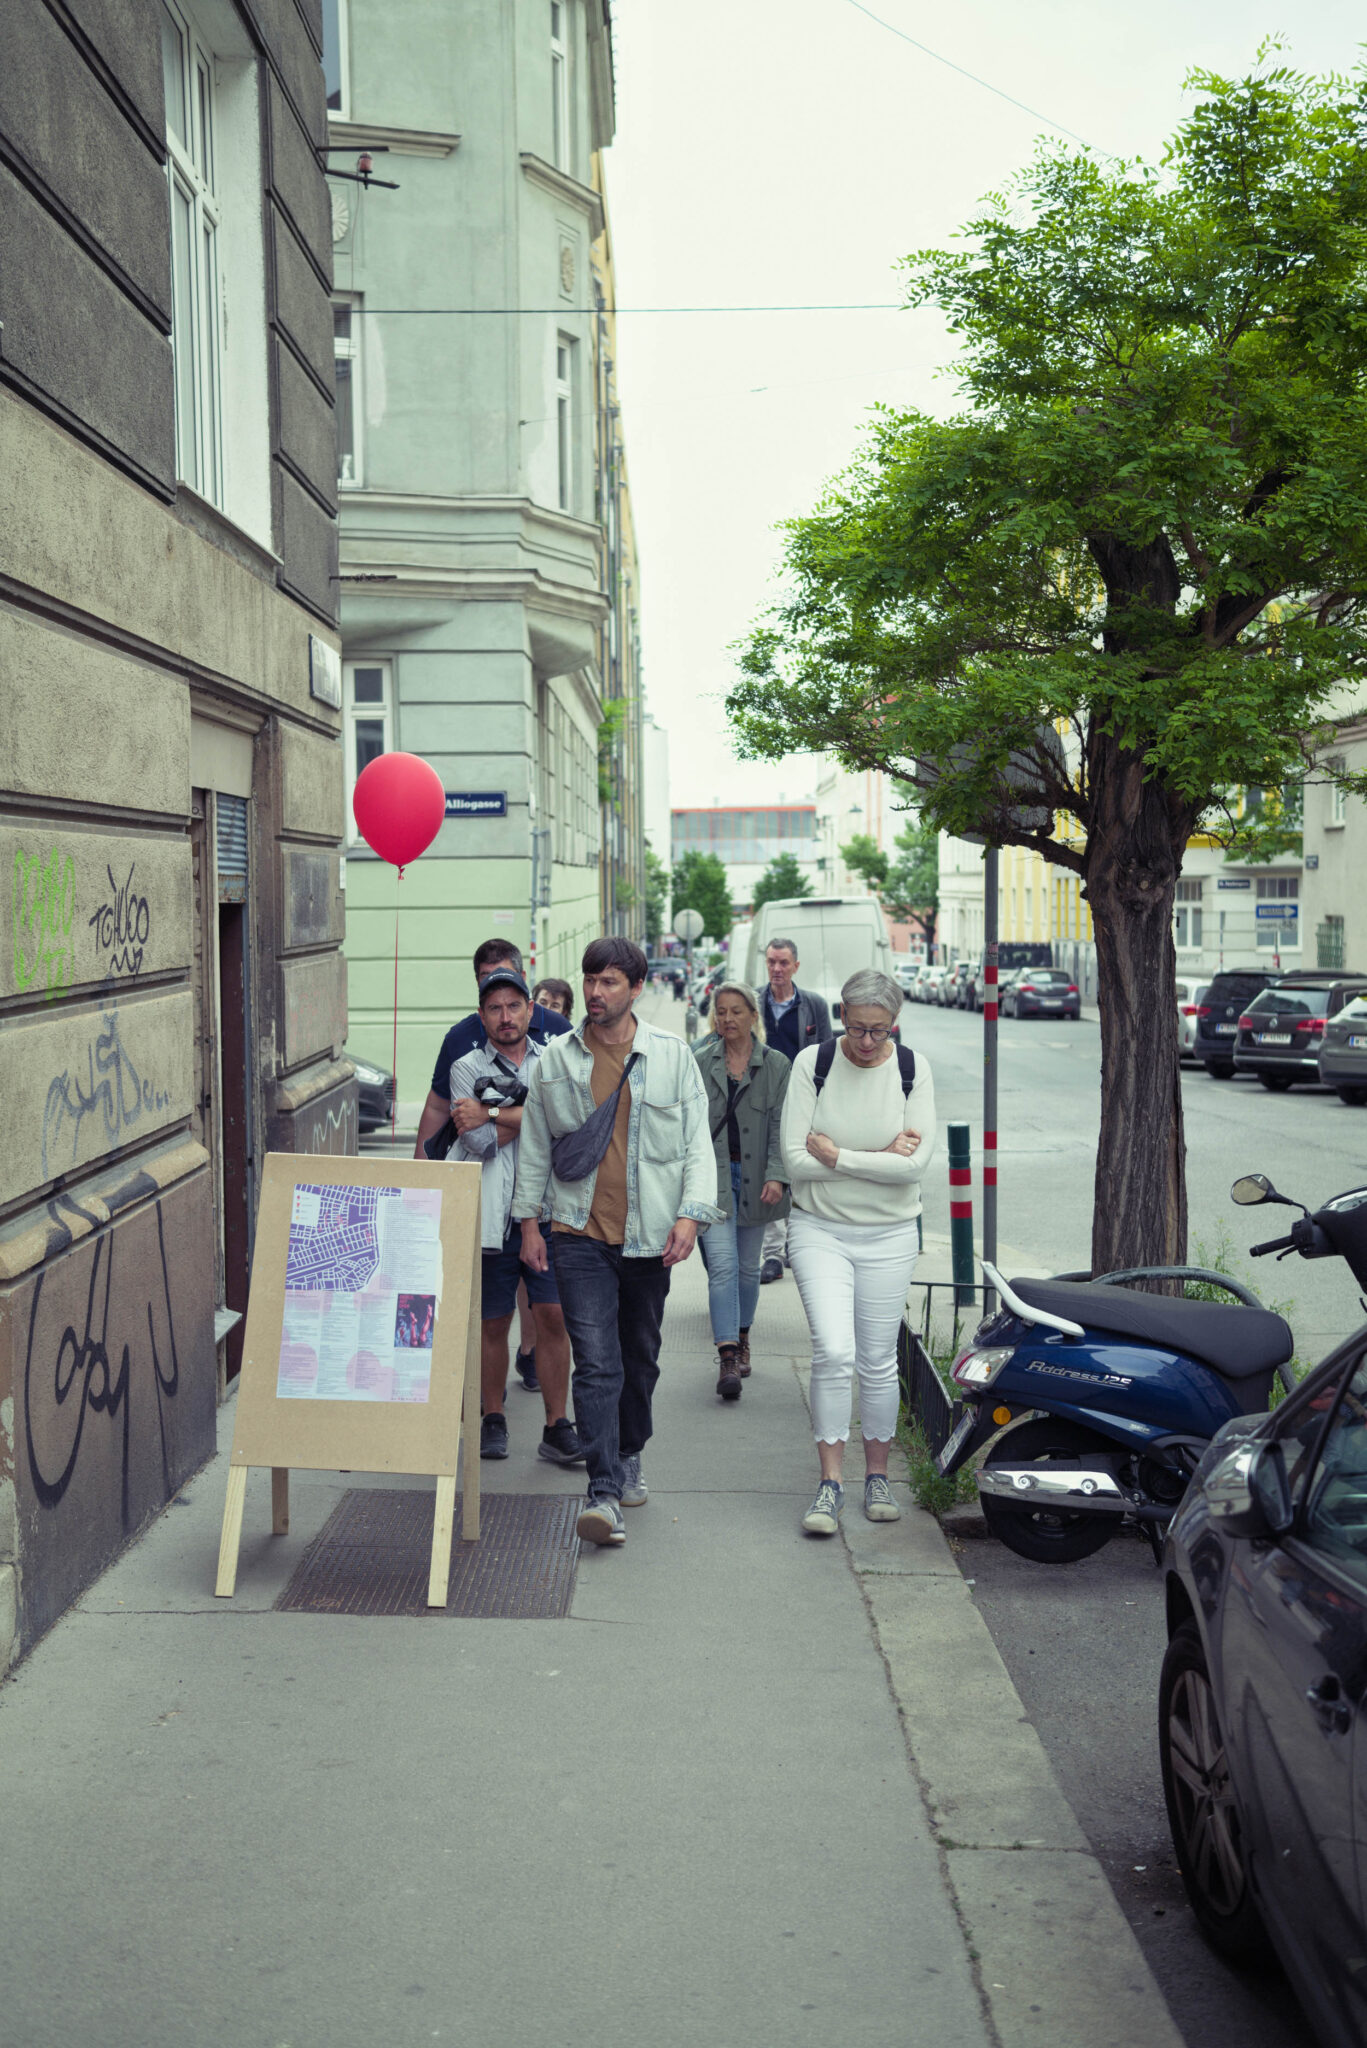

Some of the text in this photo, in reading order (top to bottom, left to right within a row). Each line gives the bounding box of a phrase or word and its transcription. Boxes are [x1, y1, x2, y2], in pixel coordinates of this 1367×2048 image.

[445, 798, 502, 811] Alliogasse
[1027, 1360, 1133, 1387] Address 125
